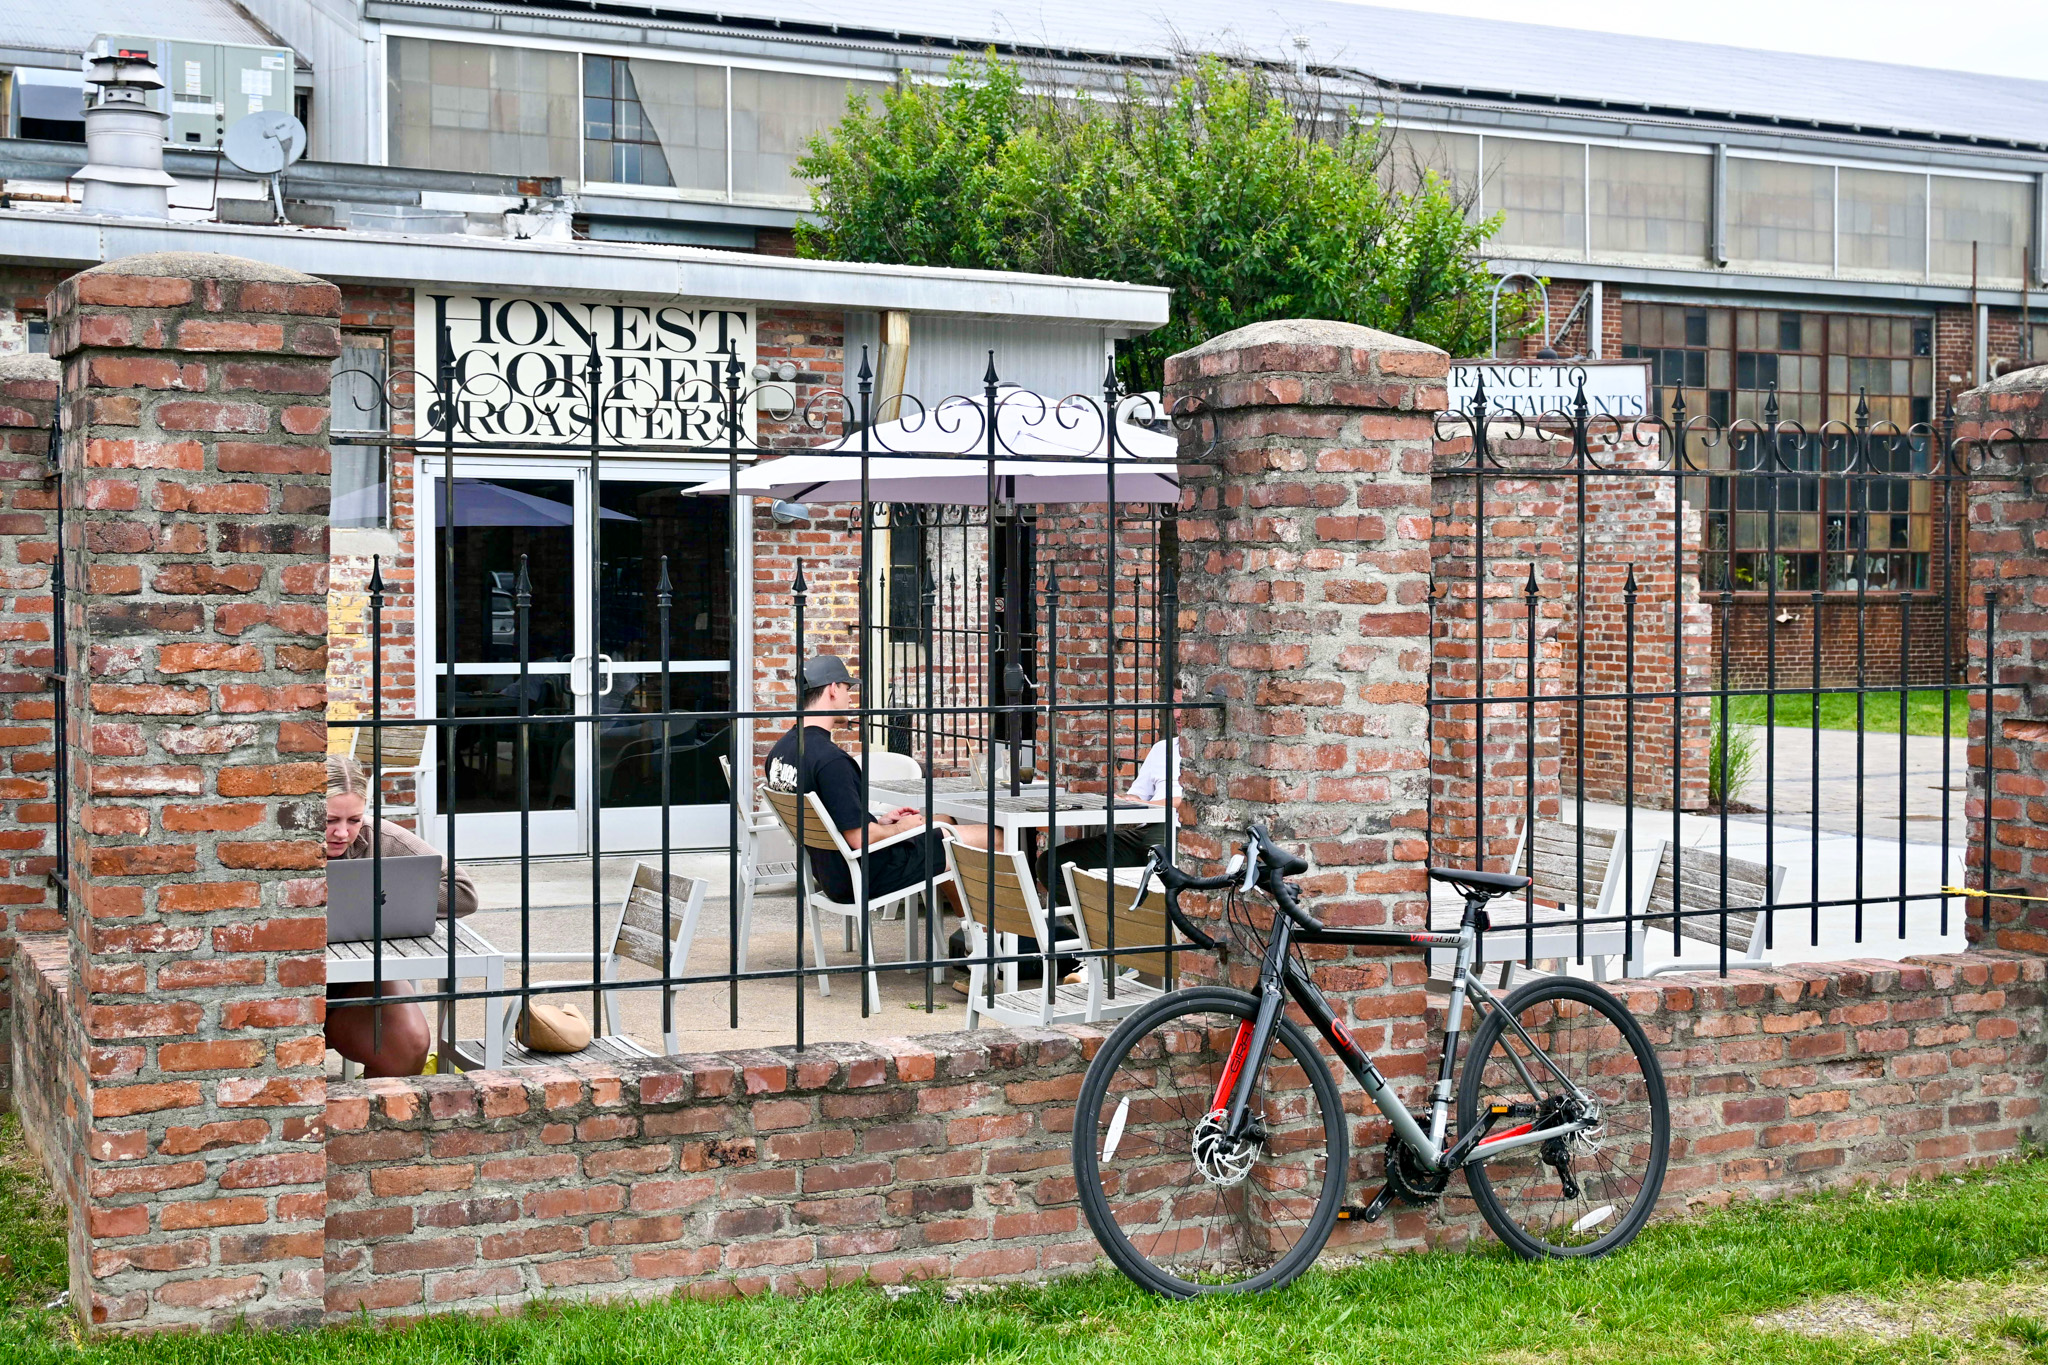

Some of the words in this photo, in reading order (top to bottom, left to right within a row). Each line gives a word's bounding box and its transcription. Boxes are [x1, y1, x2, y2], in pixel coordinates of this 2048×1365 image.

[426, 294, 747, 394] HONEST
[456, 349, 747, 404] COFFEE
[1450, 366, 1542, 388] RANCE
[1549, 366, 1587, 388] TO
[457, 401, 746, 441] ROASTERS
[1230, 1031, 1251, 1073] GIRA
